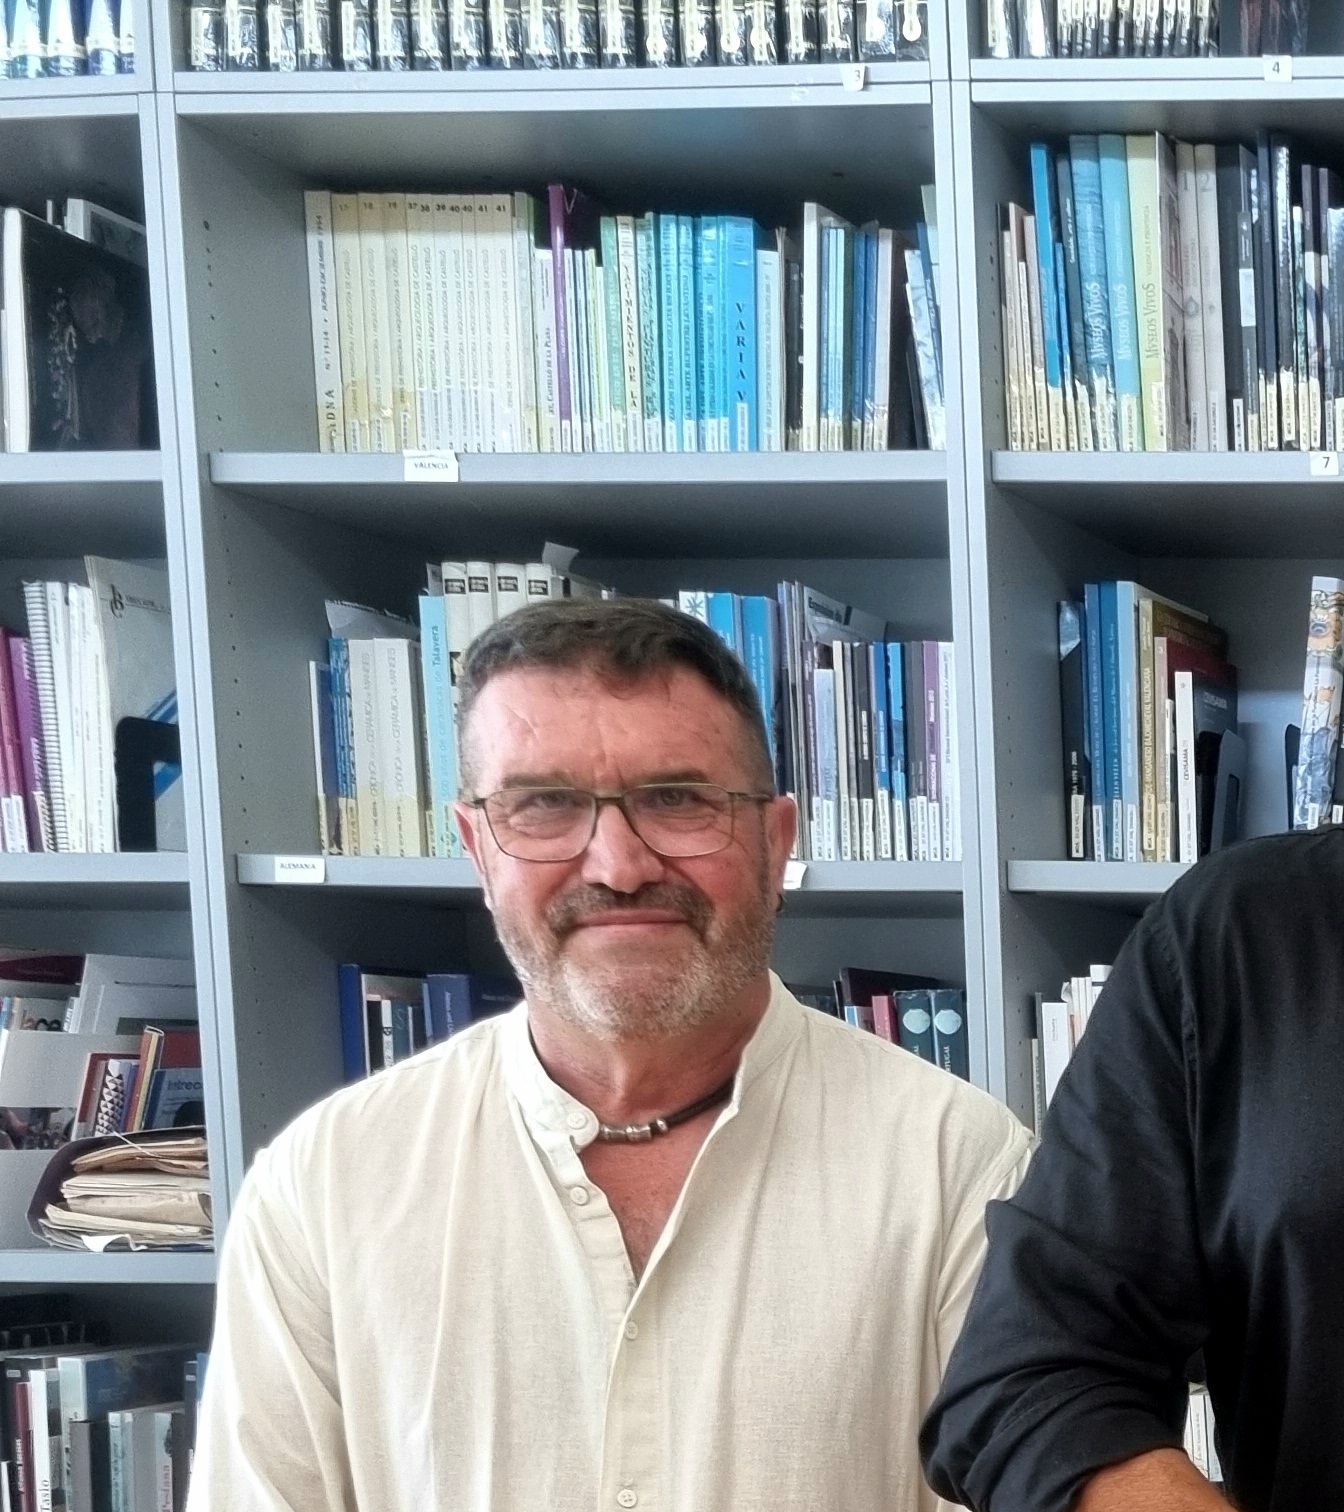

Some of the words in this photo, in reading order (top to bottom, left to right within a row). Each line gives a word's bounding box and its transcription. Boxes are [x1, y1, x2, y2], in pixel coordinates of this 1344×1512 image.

[1272, 62, 1280, 73] 4
[1322, 456, 1330, 468] 7
[430, 625, 441, 667] Talavera
